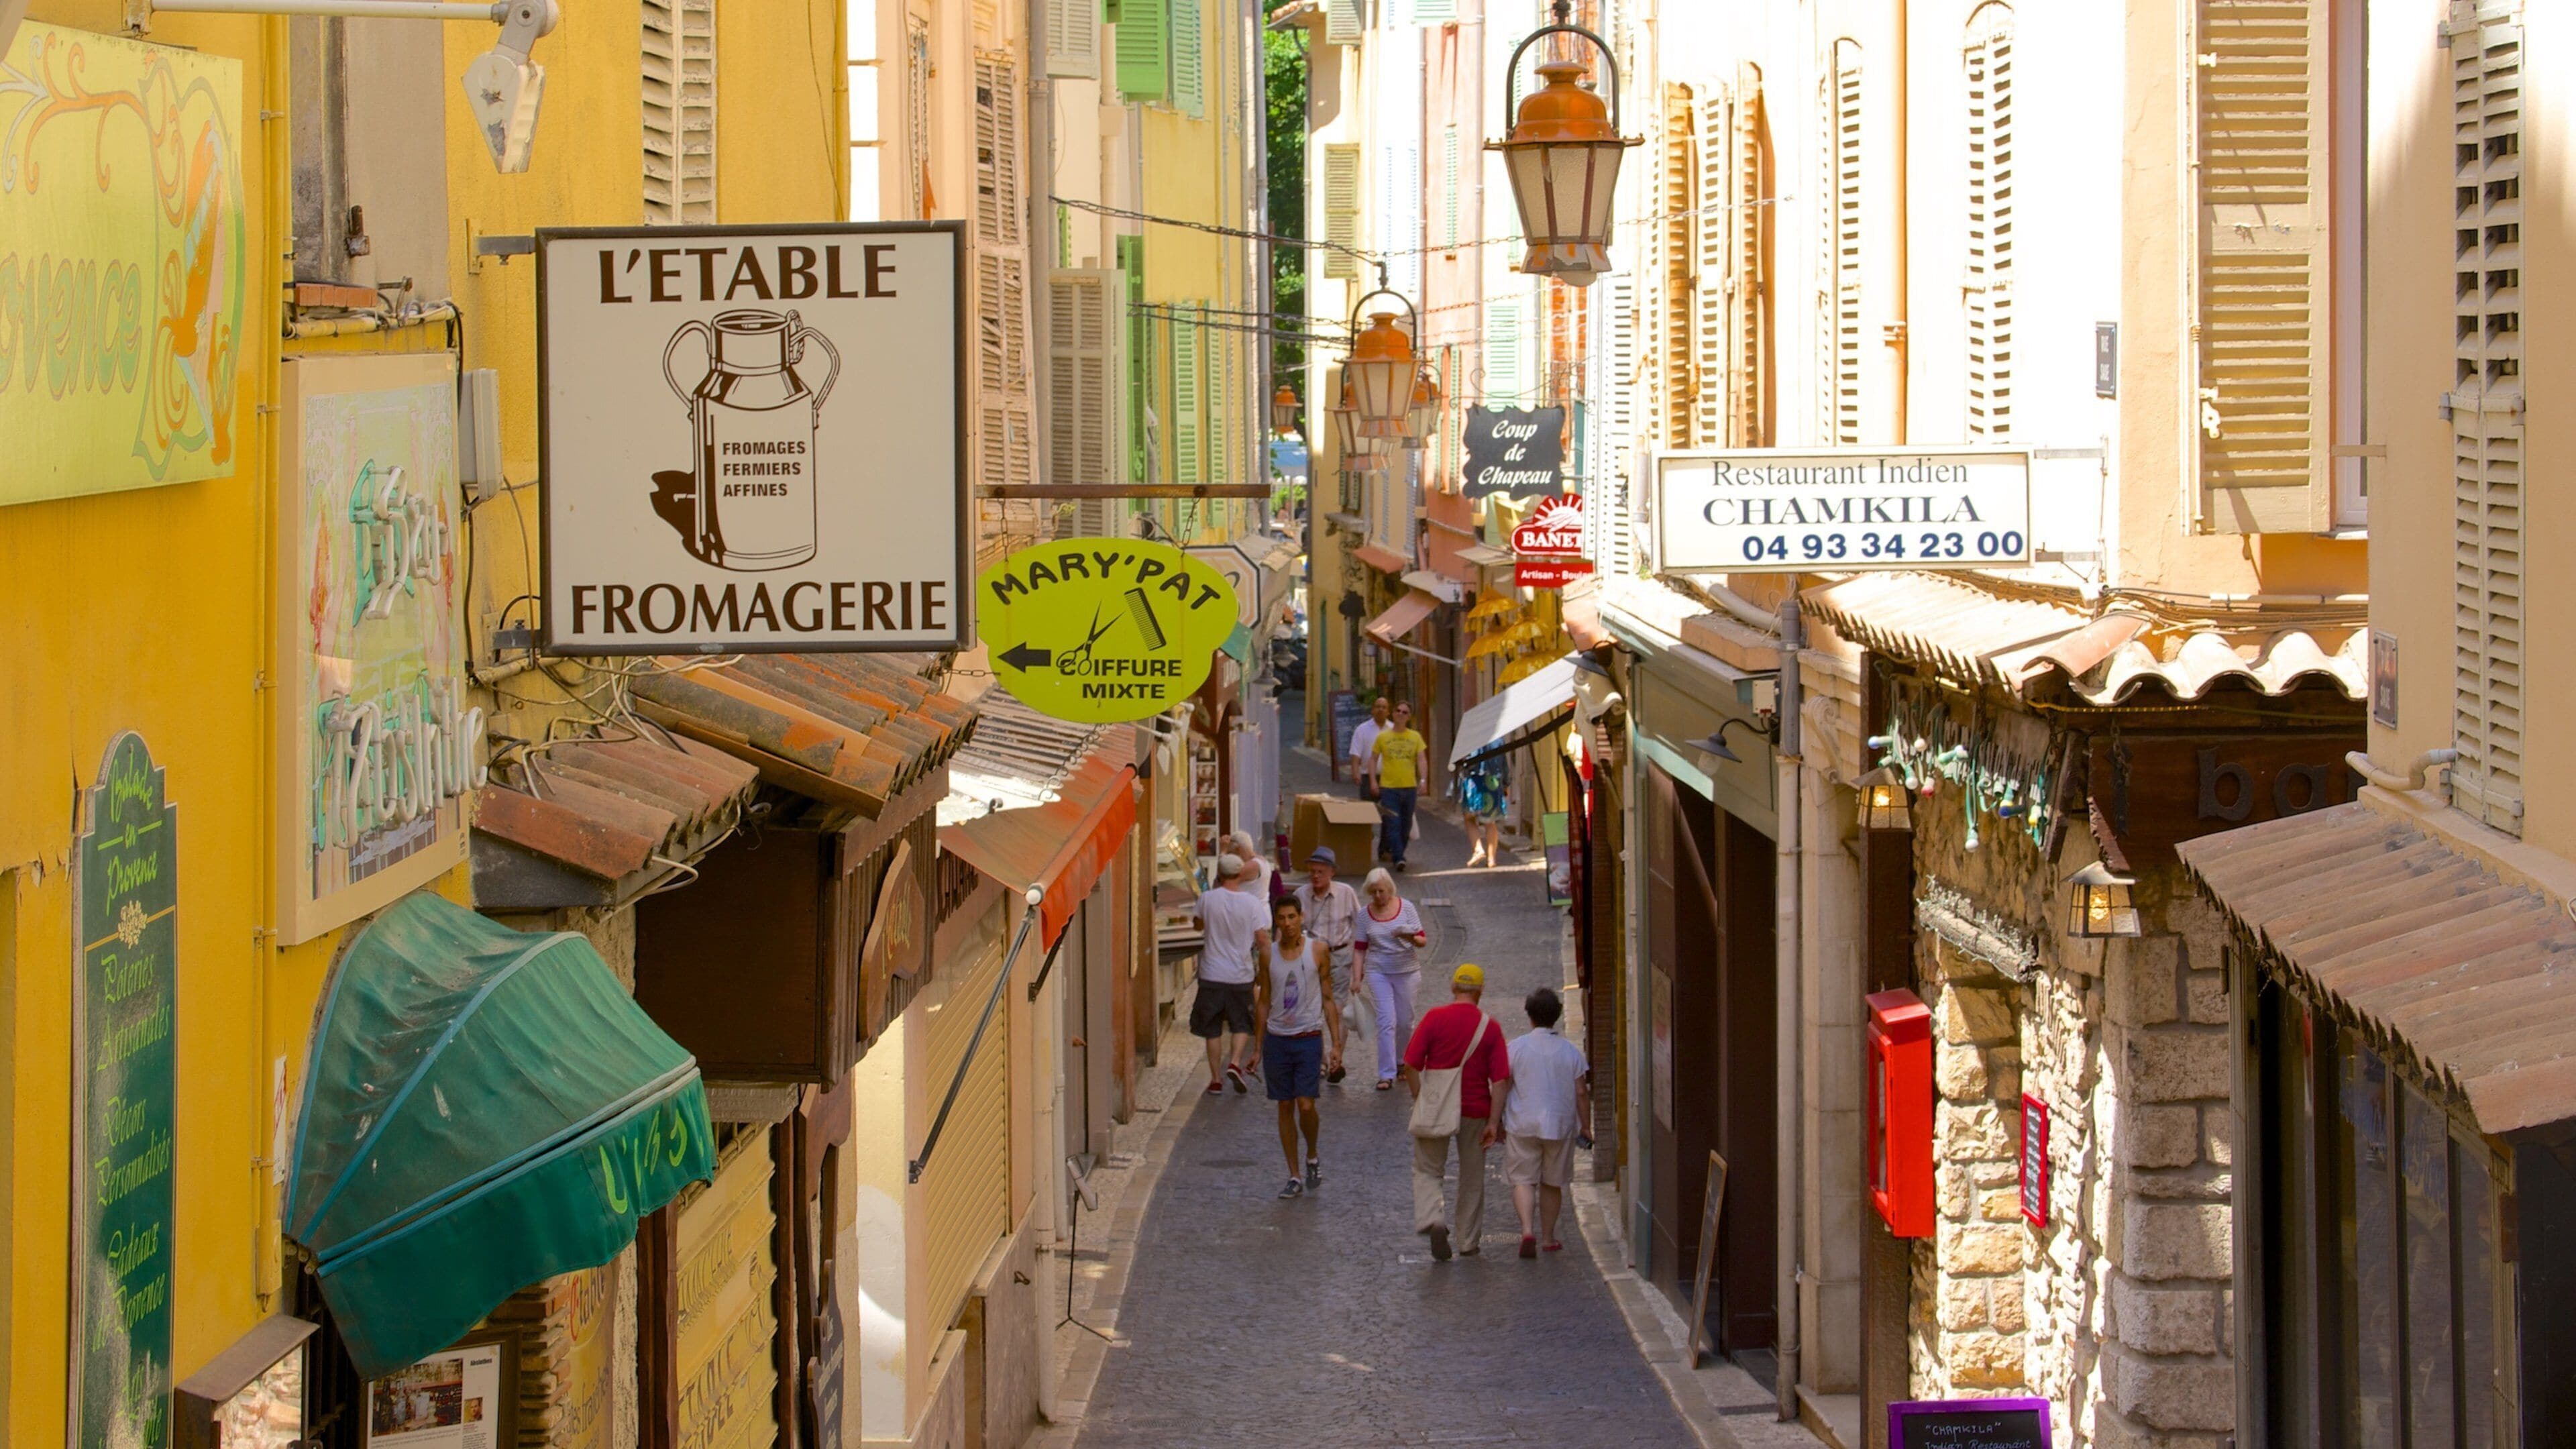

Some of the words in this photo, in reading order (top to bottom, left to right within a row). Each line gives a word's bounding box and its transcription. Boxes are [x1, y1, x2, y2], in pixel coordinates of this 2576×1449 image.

[599, 244, 898, 304] L'ETABLE
[1491, 419, 1538, 441] Coup
[722, 441, 806, 455] FROMAGES
[1504, 443, 1526, 462] de
[722, 462, 802, 476] FERMIERS
[1477, 466, 1553, 488] Chapeau
[1712, 460, 1866, 486] Restaurant
[1878, 457, 1968, 484] Indien
[722, 484, 788, 498] AFFINES
[1702, 494, 1986, 527] CHAMKILA
[1743, 535, 1789, 561] 04
[1801, 534, 1847, 559] 93
[1860, 533, 1905, 558] 34
[1919, 533, 1964, 557] 23
[1977, 531, 2024, 557] 00
[991, 551, 1221, 610] MARY'PAT
[1521, 570, 1553, 580] Artisan
[571, 580, 948, 635] FROMAGERIE
[1082, 684, 1165, 699] MIXTE
[109, 750, 154, 823] Balade
[106, 850, 158, 917] Provence
[101, 949, 155, 1004] Poteries
[96, 991, 170, 1073] Artisanales
[103, 1096, 147, 1147] Décors
[106, 1222, 160, 1287] Cadeaux
[113, 1272, 166, 1334] Provence
